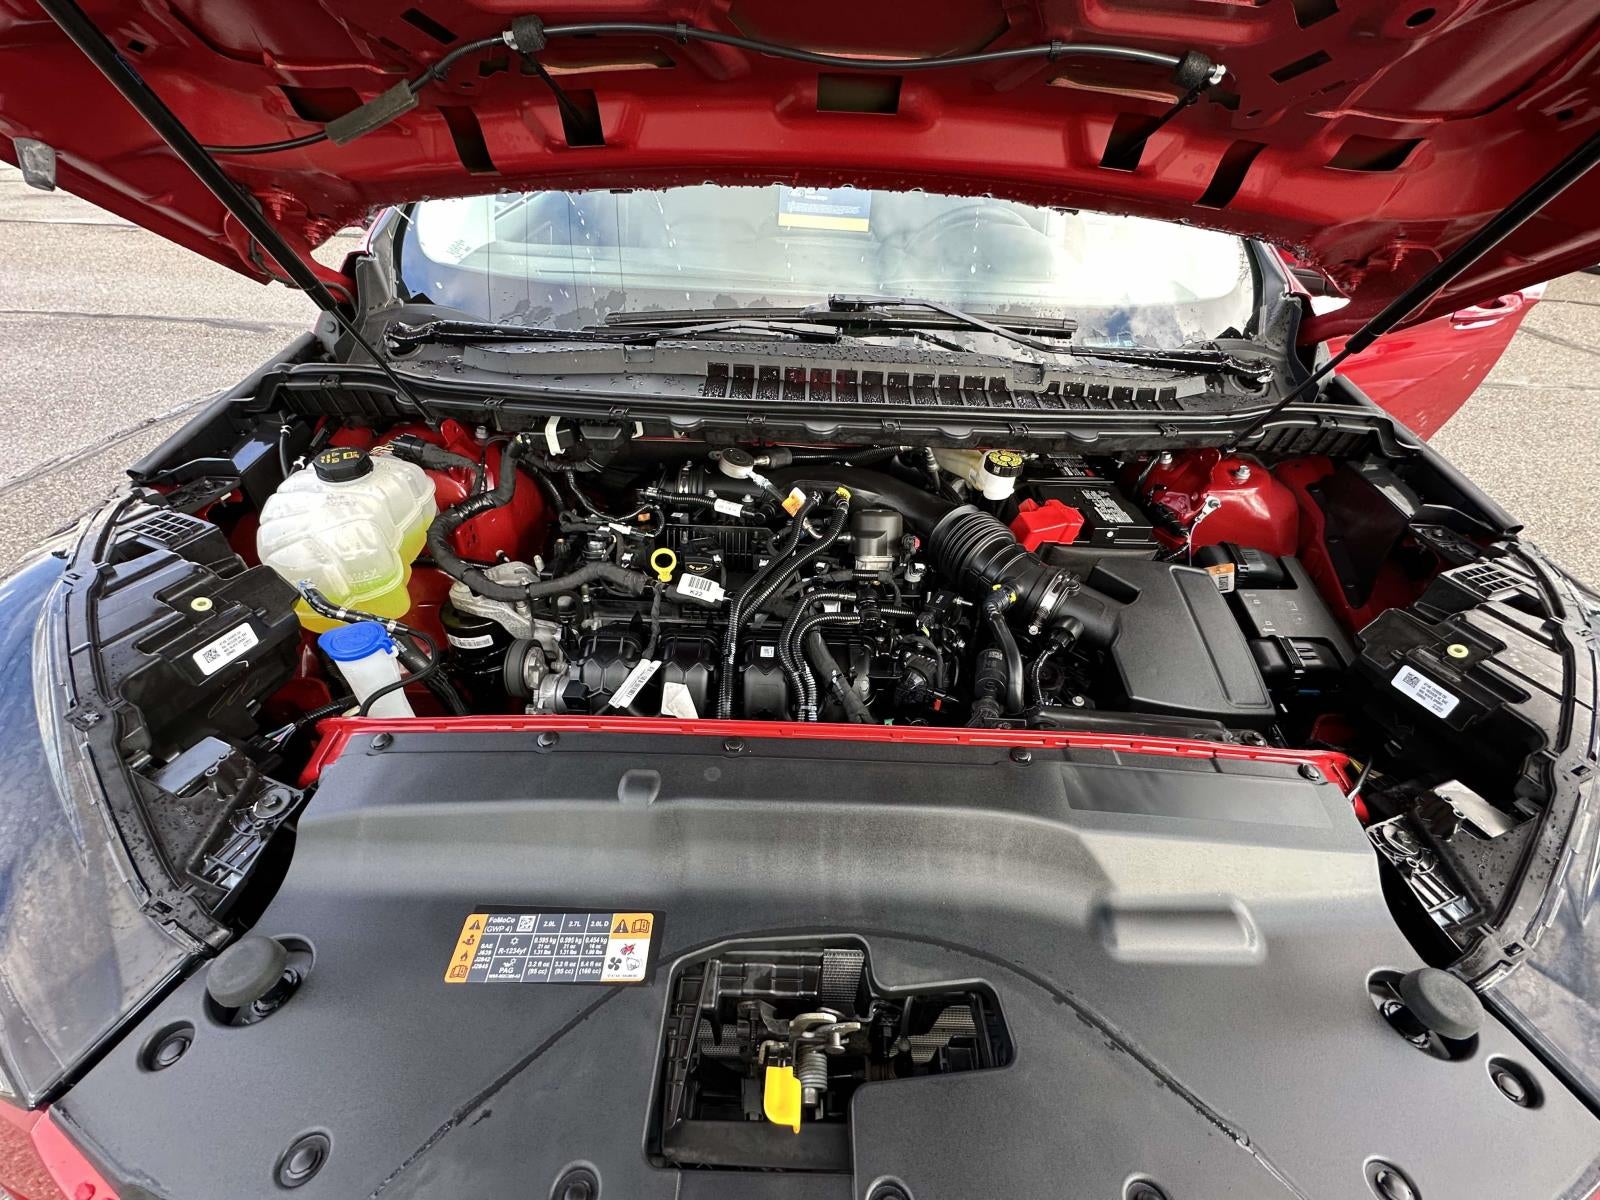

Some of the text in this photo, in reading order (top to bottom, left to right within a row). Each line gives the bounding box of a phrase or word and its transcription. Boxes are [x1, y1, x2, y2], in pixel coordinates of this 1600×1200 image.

[489, 916, 516, 924] FoMoCo
[548, 936, 556, 944] kg
[574, 936, 582, 944] kg
[600, 936, 608, 944] kg
[498, 947, 527, 956] R-1234yf
